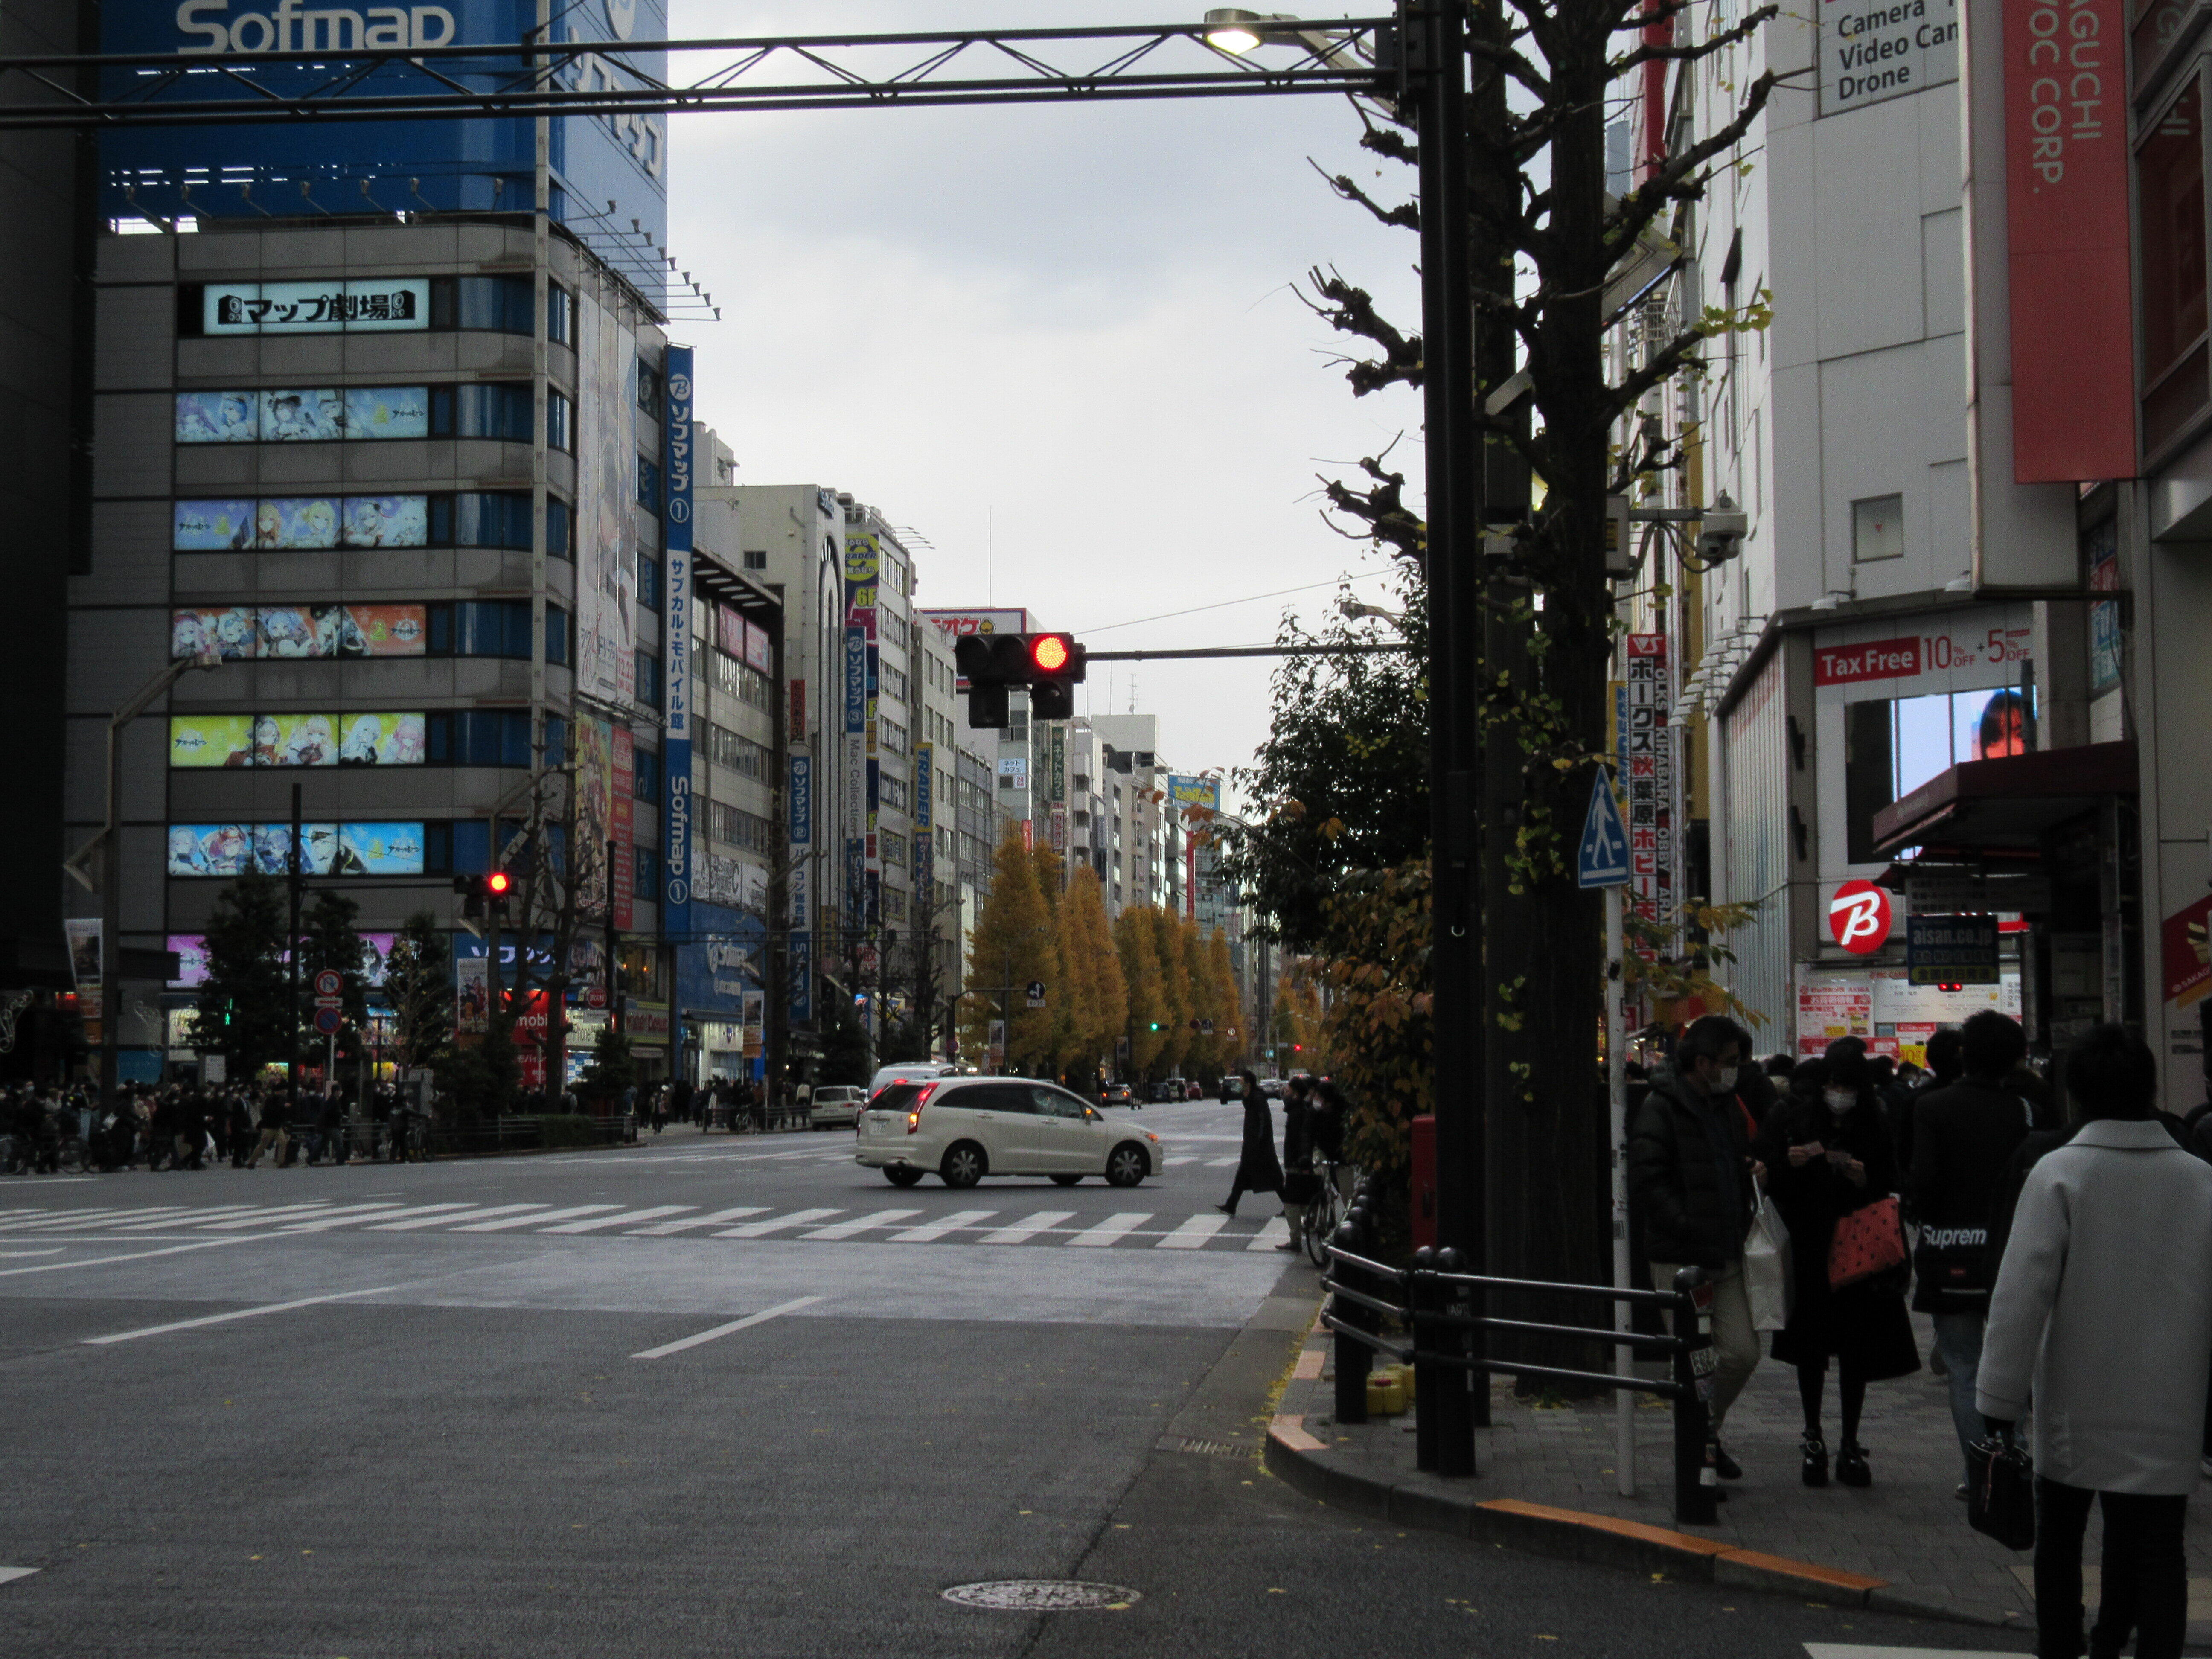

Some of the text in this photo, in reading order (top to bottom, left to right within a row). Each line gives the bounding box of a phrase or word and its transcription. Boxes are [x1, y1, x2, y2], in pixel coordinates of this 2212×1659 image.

[176, 0, 456, 66] Sofmap
[1838, 0, 1924, 37] Camera
[1839, 37, 1909, 70] Video
[2069, 0, 2102, 140] GUCHI
[1839, 66, 1909, 100] Drone
[2029, 0, 2064, 194] OC CORP.
[244, 294, 390, 323] マップ劇場
[671, 404, 689, 492] ソフマップ
[856, 588, 877, 607] 6F
[849, 655, 862, 706] ソフマップ
[1822, 649, 1914, 677] Tax Free
[795, 777, 806, 823] ソフマップ
[918, 749, 930, 826] TRADER
[1631, 659, 1658, 963] ボークス秋葉原ホビー天
